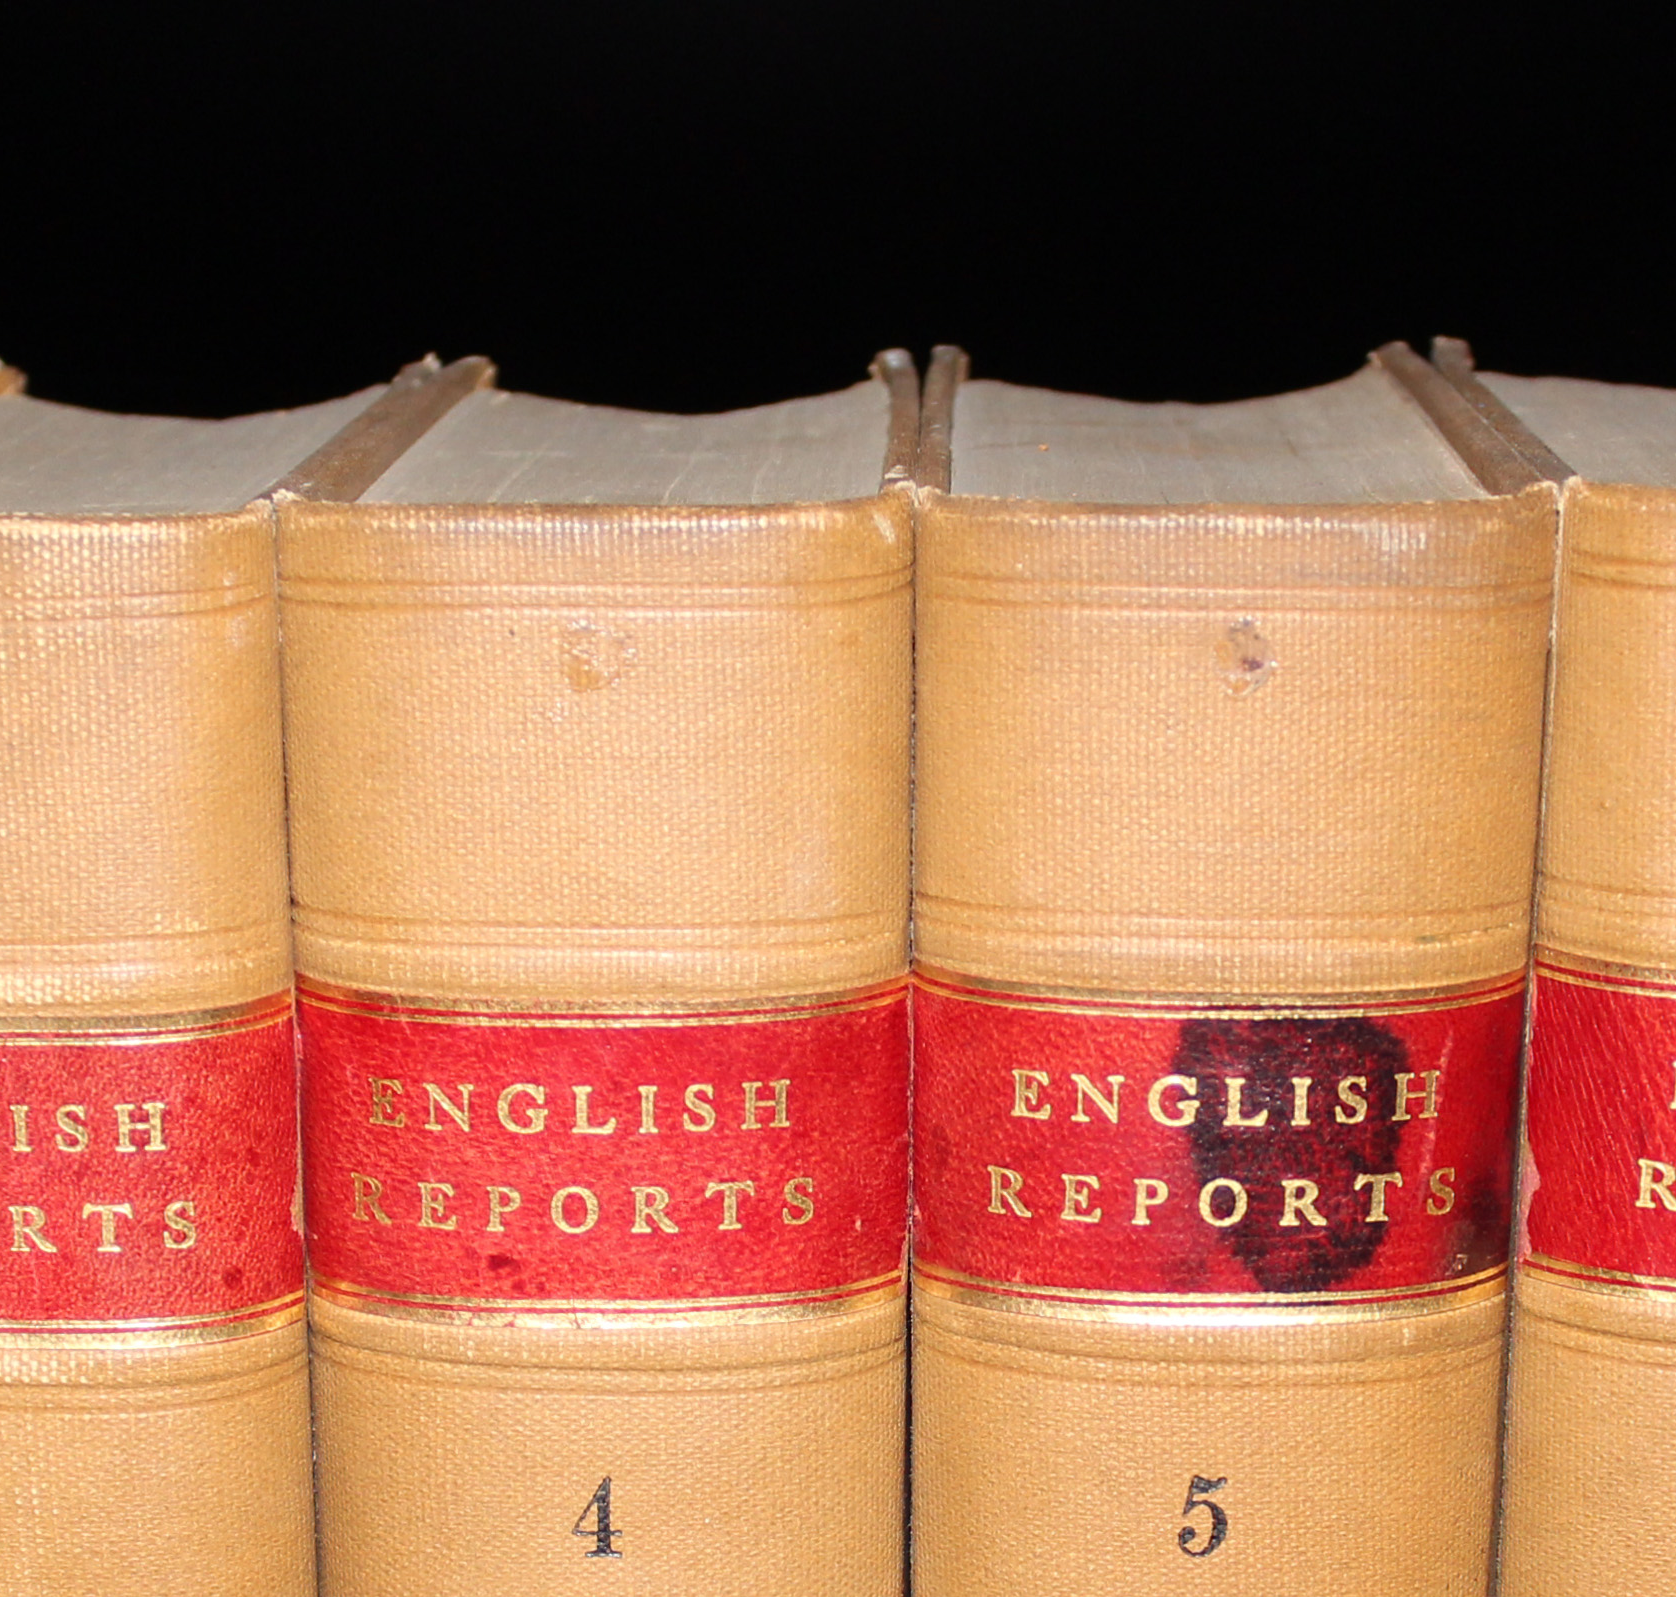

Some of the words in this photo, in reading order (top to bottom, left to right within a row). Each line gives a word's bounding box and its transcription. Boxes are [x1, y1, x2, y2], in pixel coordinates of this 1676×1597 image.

[369, 1075, 793, 1137] ENGLISH
[1010, 1067, 1443, 1129] ENGLISH
[350, 1171, 817, 1236] REPORTS
[987, 1164, 1457, 1228] REPORTS
[571, 1475, 623, 1558] 4
[1178, 1475, 1228, 1557] 5
